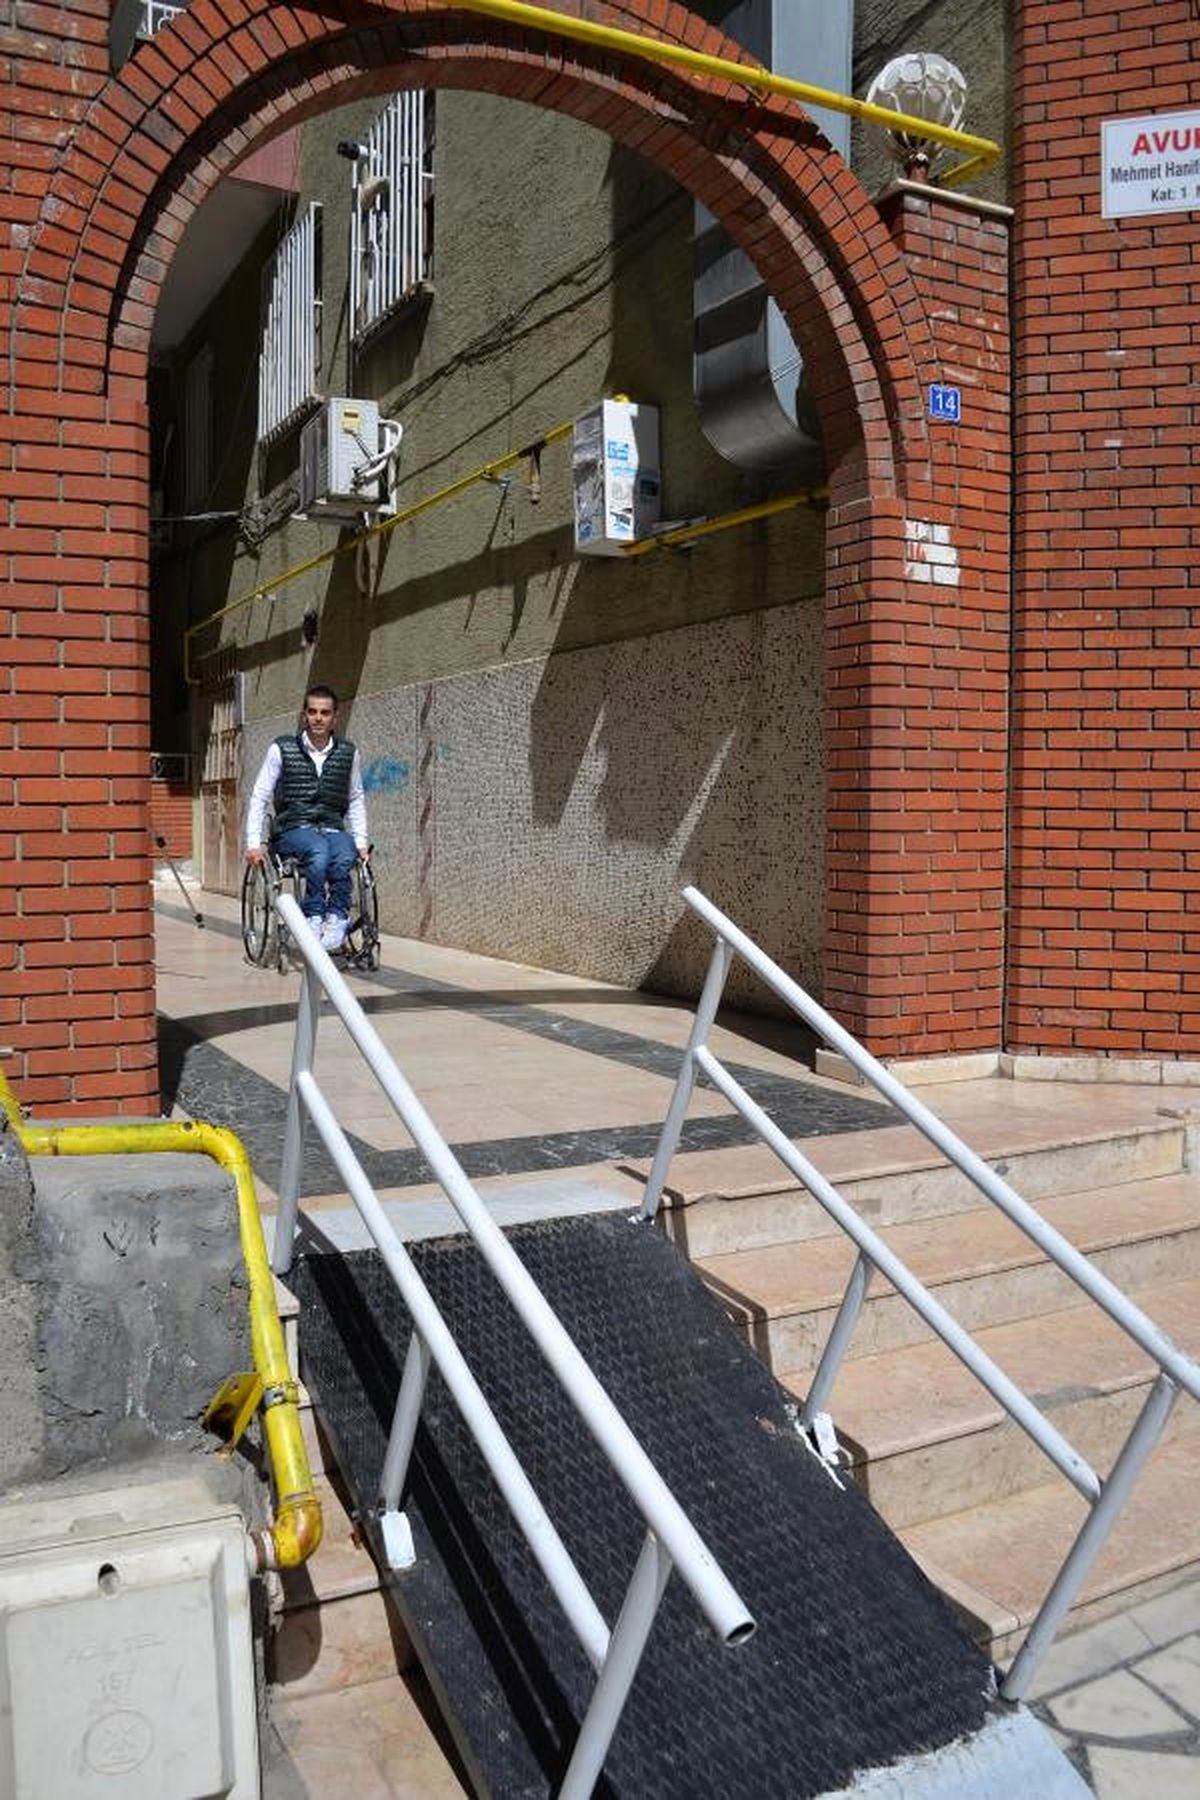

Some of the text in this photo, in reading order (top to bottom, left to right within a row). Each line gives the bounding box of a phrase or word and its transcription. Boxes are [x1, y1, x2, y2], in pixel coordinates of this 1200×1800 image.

[1110, 163, 1162, 184] Mehmet
[1180, 186, 1187, 199] 1
[935, 393, 956, 411] 14
